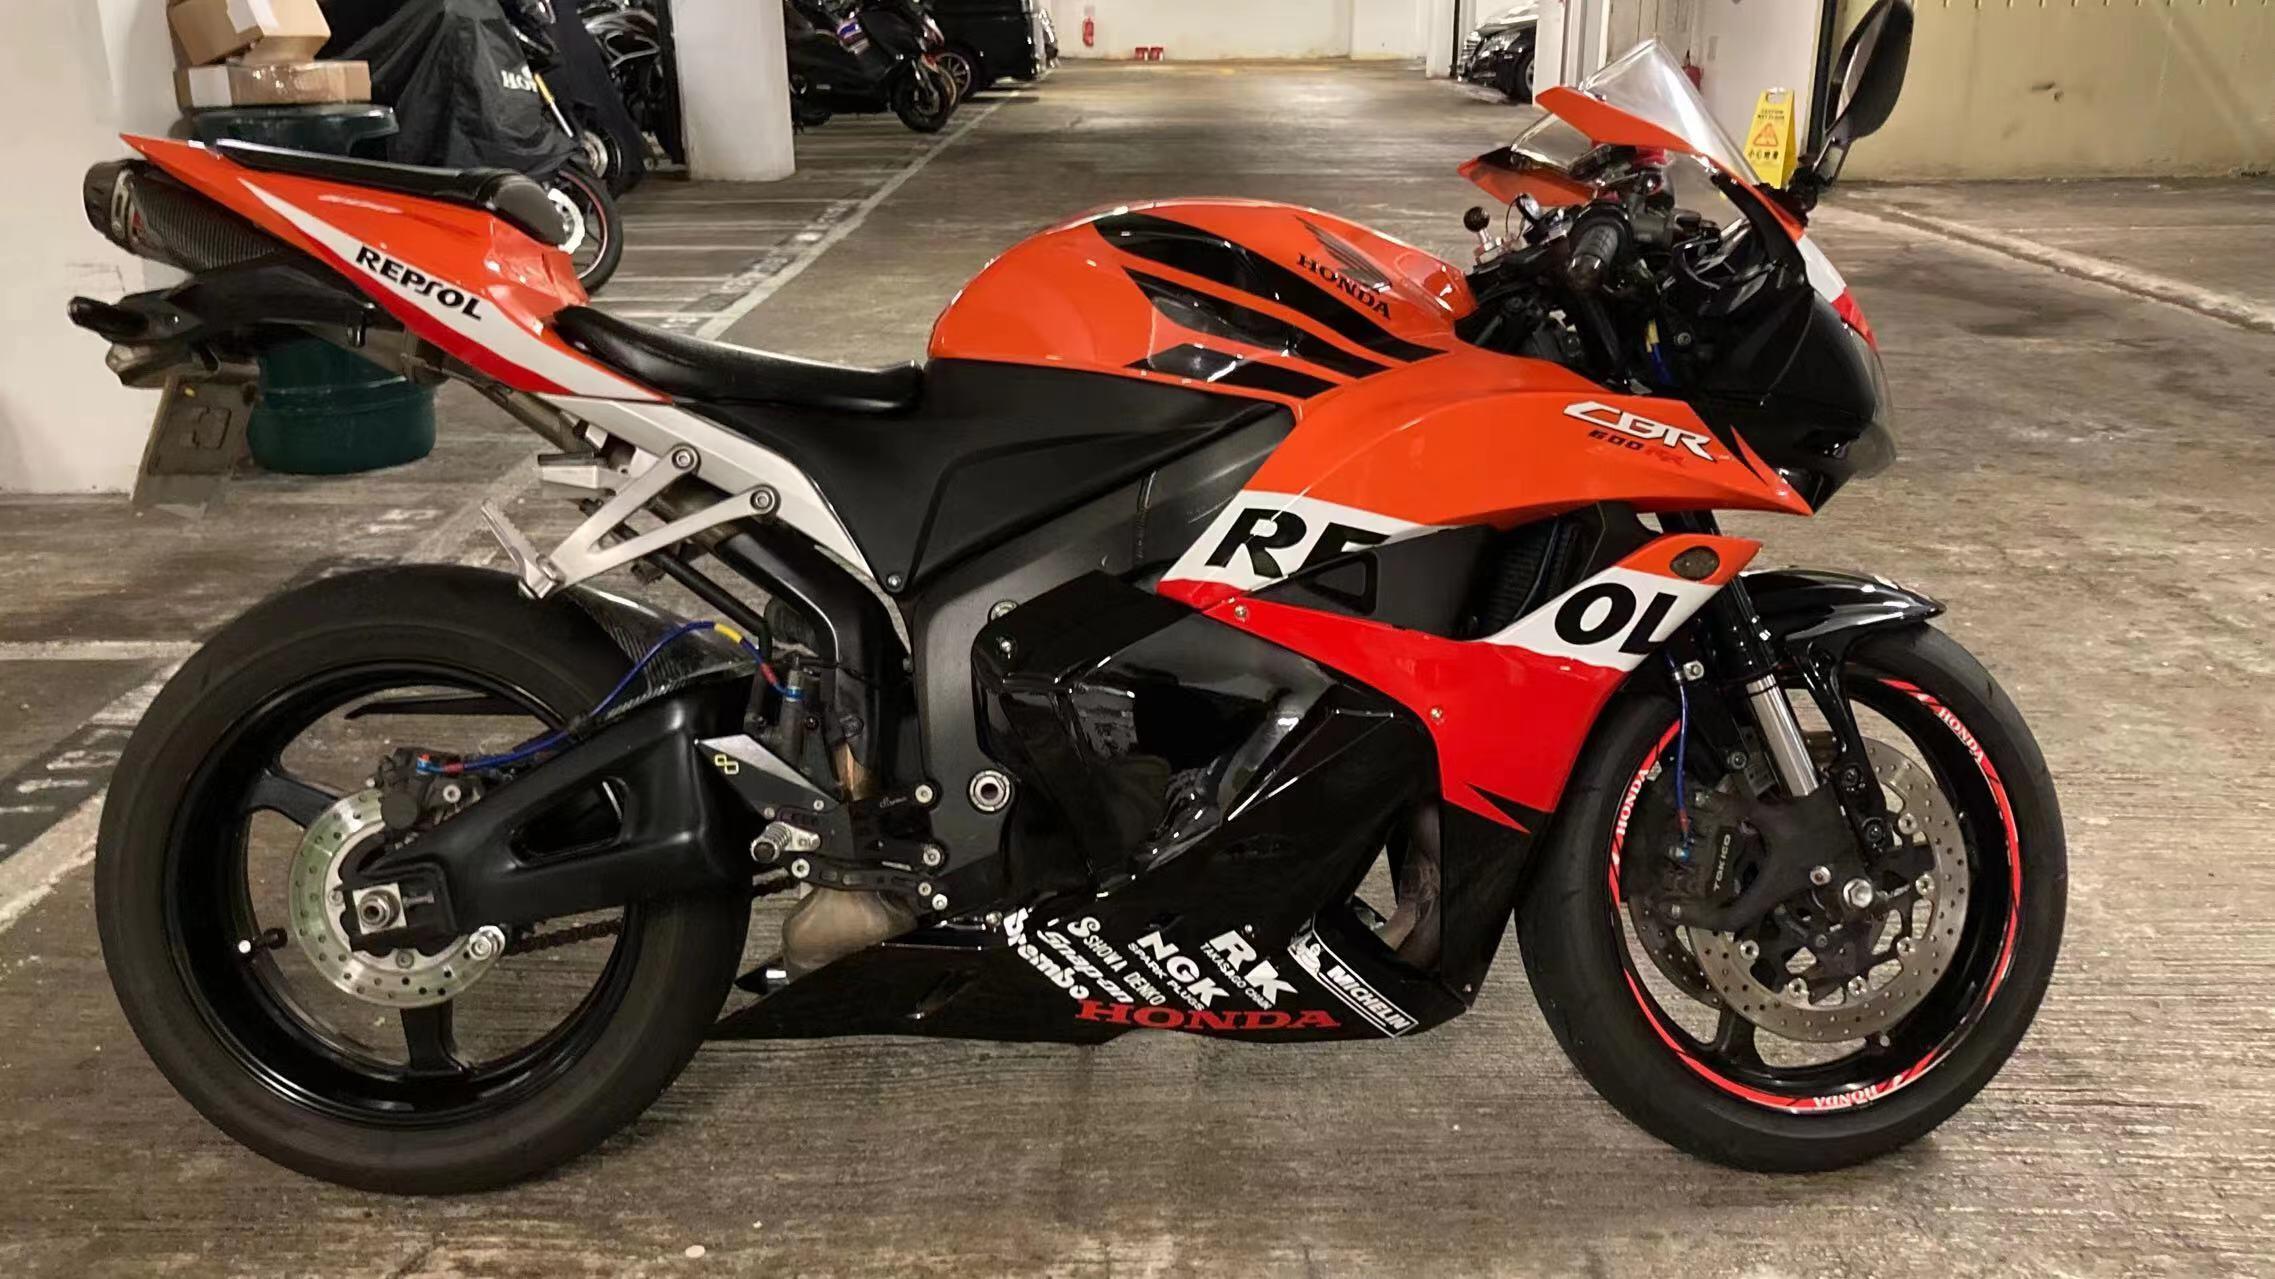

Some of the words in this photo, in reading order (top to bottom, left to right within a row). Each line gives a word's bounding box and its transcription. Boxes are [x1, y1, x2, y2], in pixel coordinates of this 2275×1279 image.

[355, 245, 482, 321] REPSOL
[1297, 252, 1391, 321] HONDA
[1563, 400, 1718, 463] CBR
[1588, 429, 1645, 451] 600
[1938, 706, 1984, 764] HONDA
[1616, 769, 1649, 836] HONDA
[1003, 906, 1090, 1000] brembo
[1036, 929, 1135, 1004] Snap-on
[1083, 934, 1128, 973] SHOWA
[1123, 971, 1167, 1006] DENKO
[1127, 942, 1168, 980] SPARK
[1166, 979, 1205, 1012] PLUGS
[1136, 930, 1231, 1008] NGK
[1200, 941, 1247, 989] TAKASAGO
[1209, 929, 1299, 1006] RK
[1076, 1000, 1342, 1031] HONDA
[1326, 964, 1411, 1031] MICHELIN
[1813, 1085, 1878, 1109] HONDA
